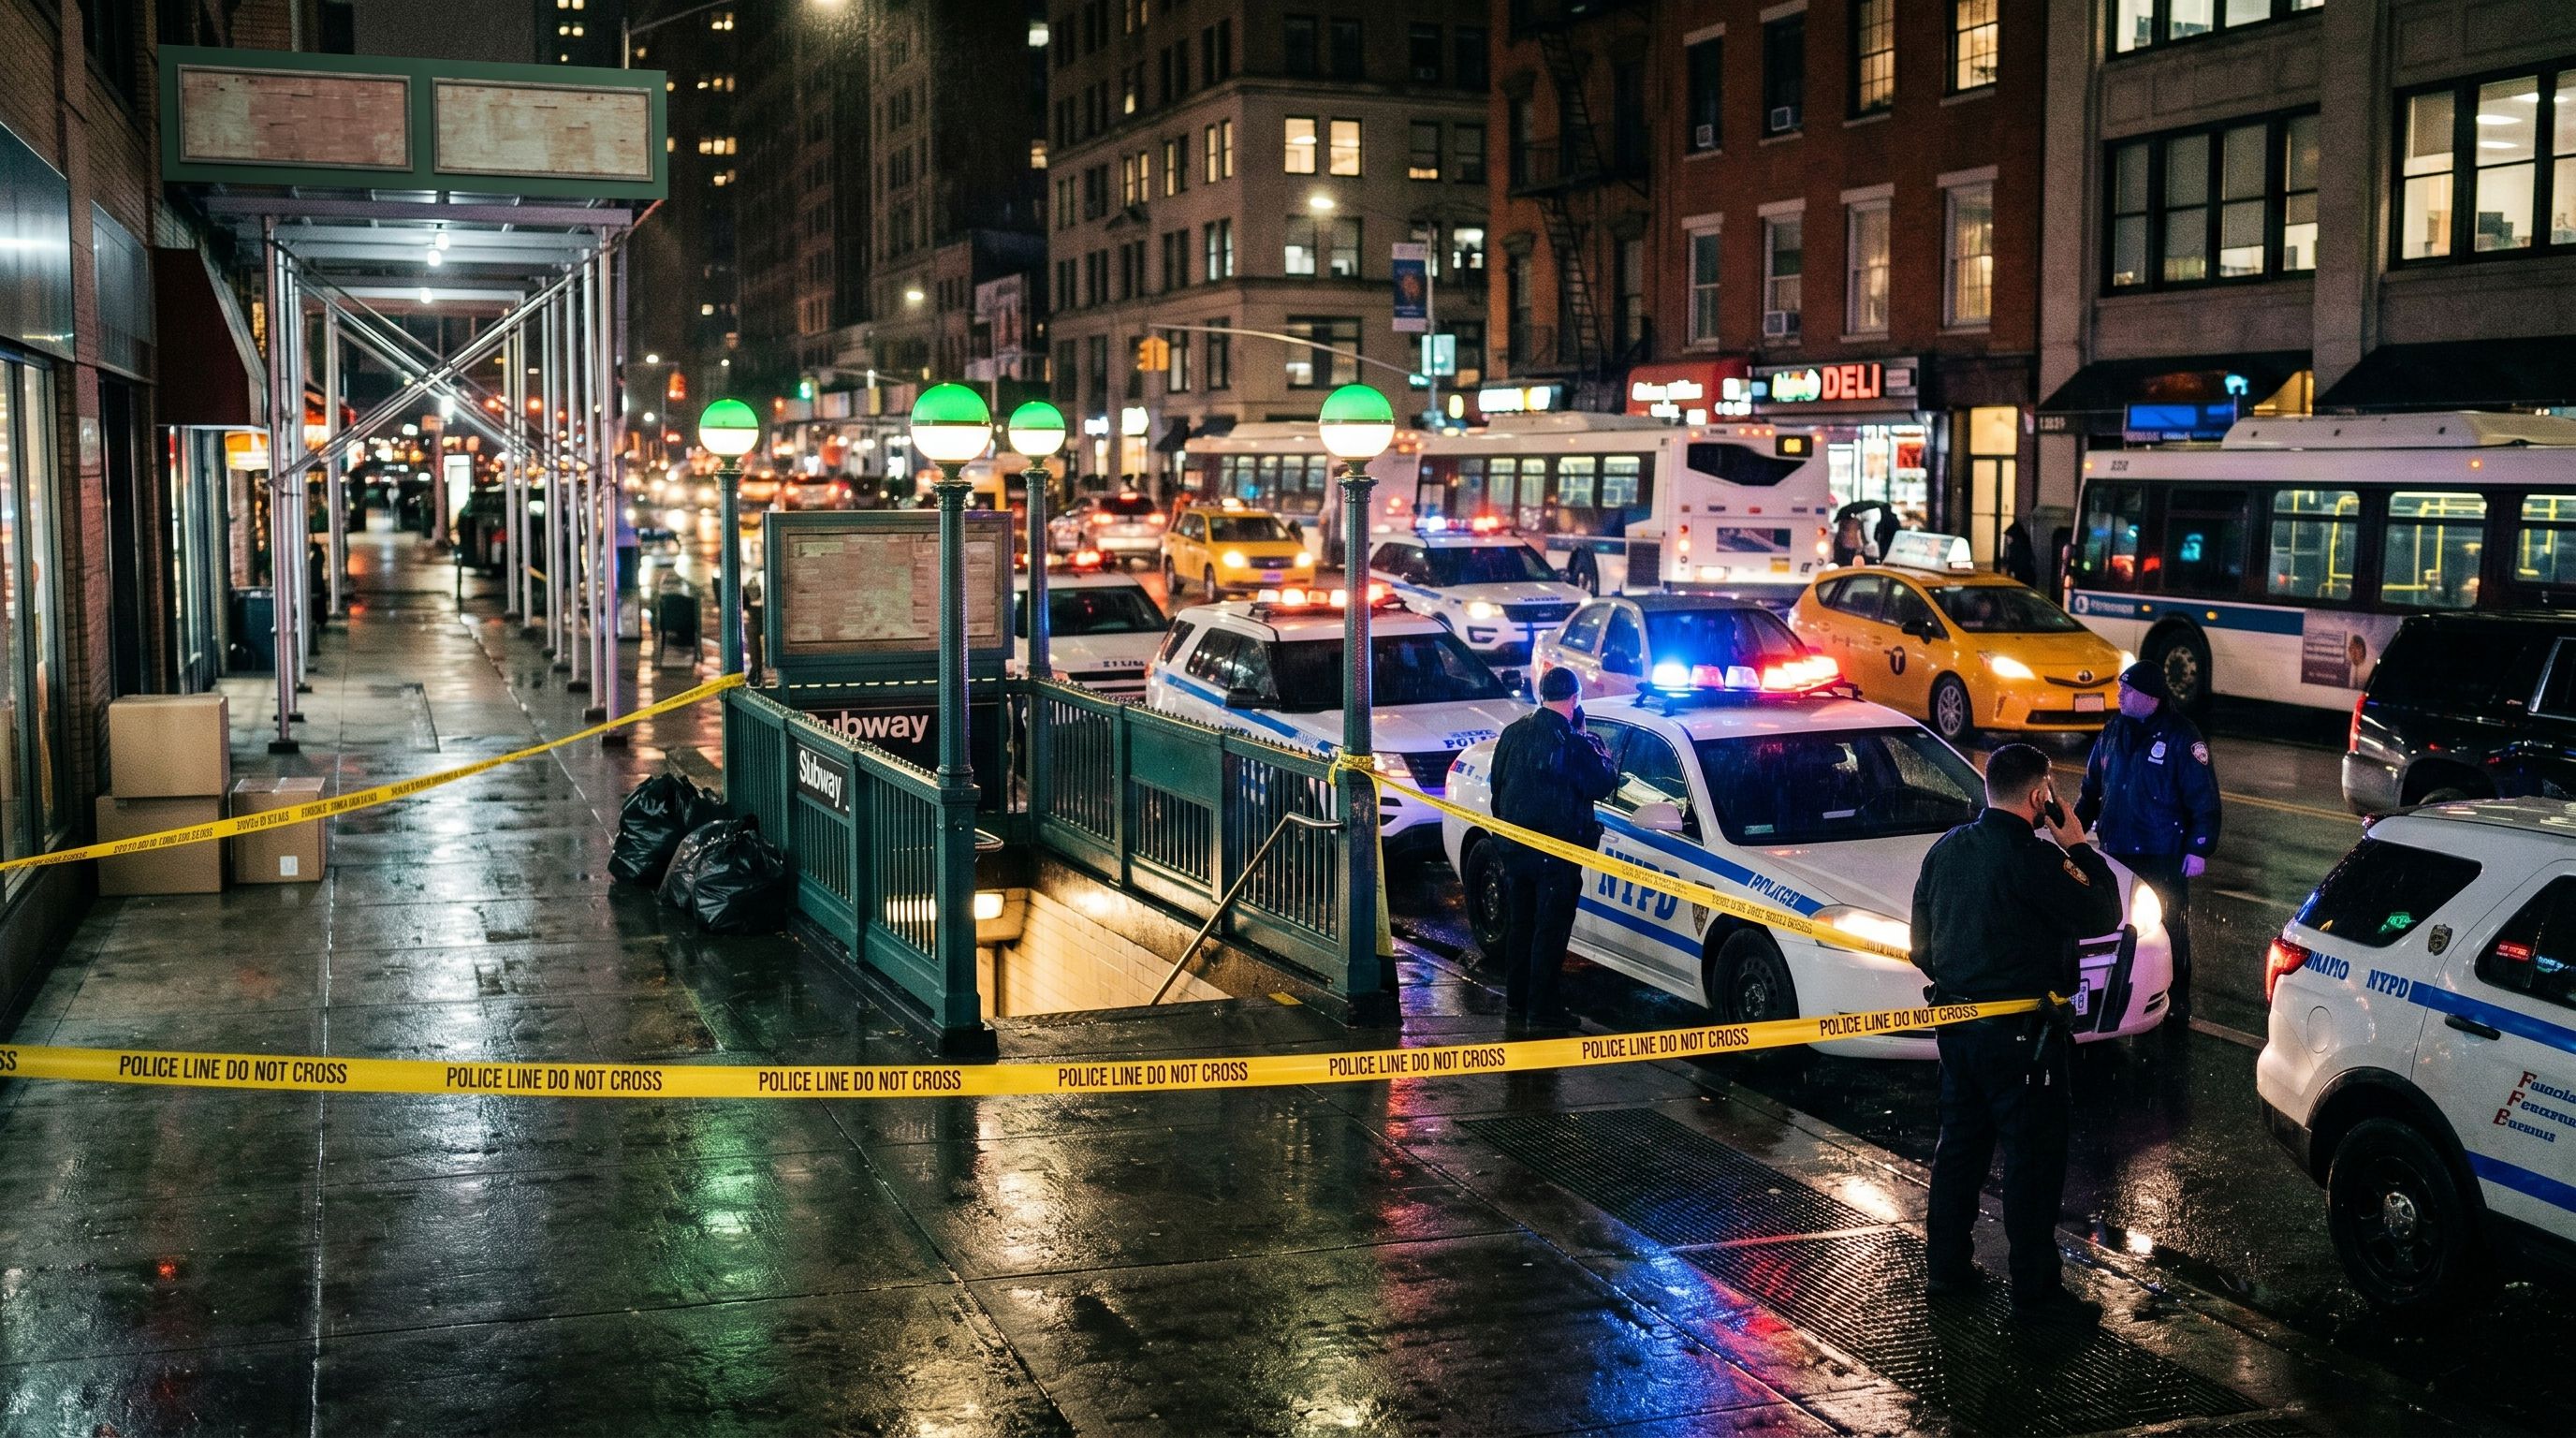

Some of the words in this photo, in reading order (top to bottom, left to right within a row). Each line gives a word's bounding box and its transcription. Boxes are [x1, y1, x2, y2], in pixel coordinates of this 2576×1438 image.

[1822, 362, 1881, 400] DELI
[798, 749, 842, 809] Subway
[1597, 846, 1681, 921] NYPD
[2365, 968, 2410, 1000] NYPD
[1820, 1016, 1861, 1037] POLICE
[1865, 1013, 1890, 1033] LINE
[1894, 1010, 1910, 1028] DO
[1913, 1007, 1936, 1025] NOT
[1939, 1004, 1979, 1021] CROSS
[1582, 1038, 1626, 1060] POLICE
[1629, 1036, 1656, 1056] LINE
[1660, 1034, 1676, 1053] DO
[1680, 1031, 1705, 1051] NOT
[1708, 1027, 1749, 1049] CROSS
[119, 1054, 179, 1078] POLICE
[183, 1057, 221, 1080] LINE
[226, 1059, 249, 1081] DO
[254, 1060, 289, 1083] NOT
[292, 1061, 348, 1085] CROSS
[1059, 1066, 1107, 1087] POLICE
[1112, 1065, 1143, 1087] LINE
[1147, 1064, 1166, 1085] DO
[1171, 1063, 1198, 1084] NOT
[1202, 1061, 1248, 1082] CROSS
[1329, 1055, 1375, 1077] POLICE
[1379, 1053, 1408, 1074] LINE
[1412, 1052, 1429, 1072] DO
[1433, 1049, 1458, 1070] NOT
[1462, 1047, 1505, 1068] CROSS
[446, 1066, 503, 1089] POLICE
[507, 1068, 542, 1090] LINE
[548, 1068, 569, 1091] DO
[574, 1069, 607, 1092] NOT
[610, 1069, 663, 1092] CROSS
[759, 1070, 812, 1092] POLICE
[816, 1070, 849, 1092] LINE
[854, 1070, 874, 1092] DO
[879, 1070, 908, 1092] NOT
[913, 1069, 961, 1092] CROSS
